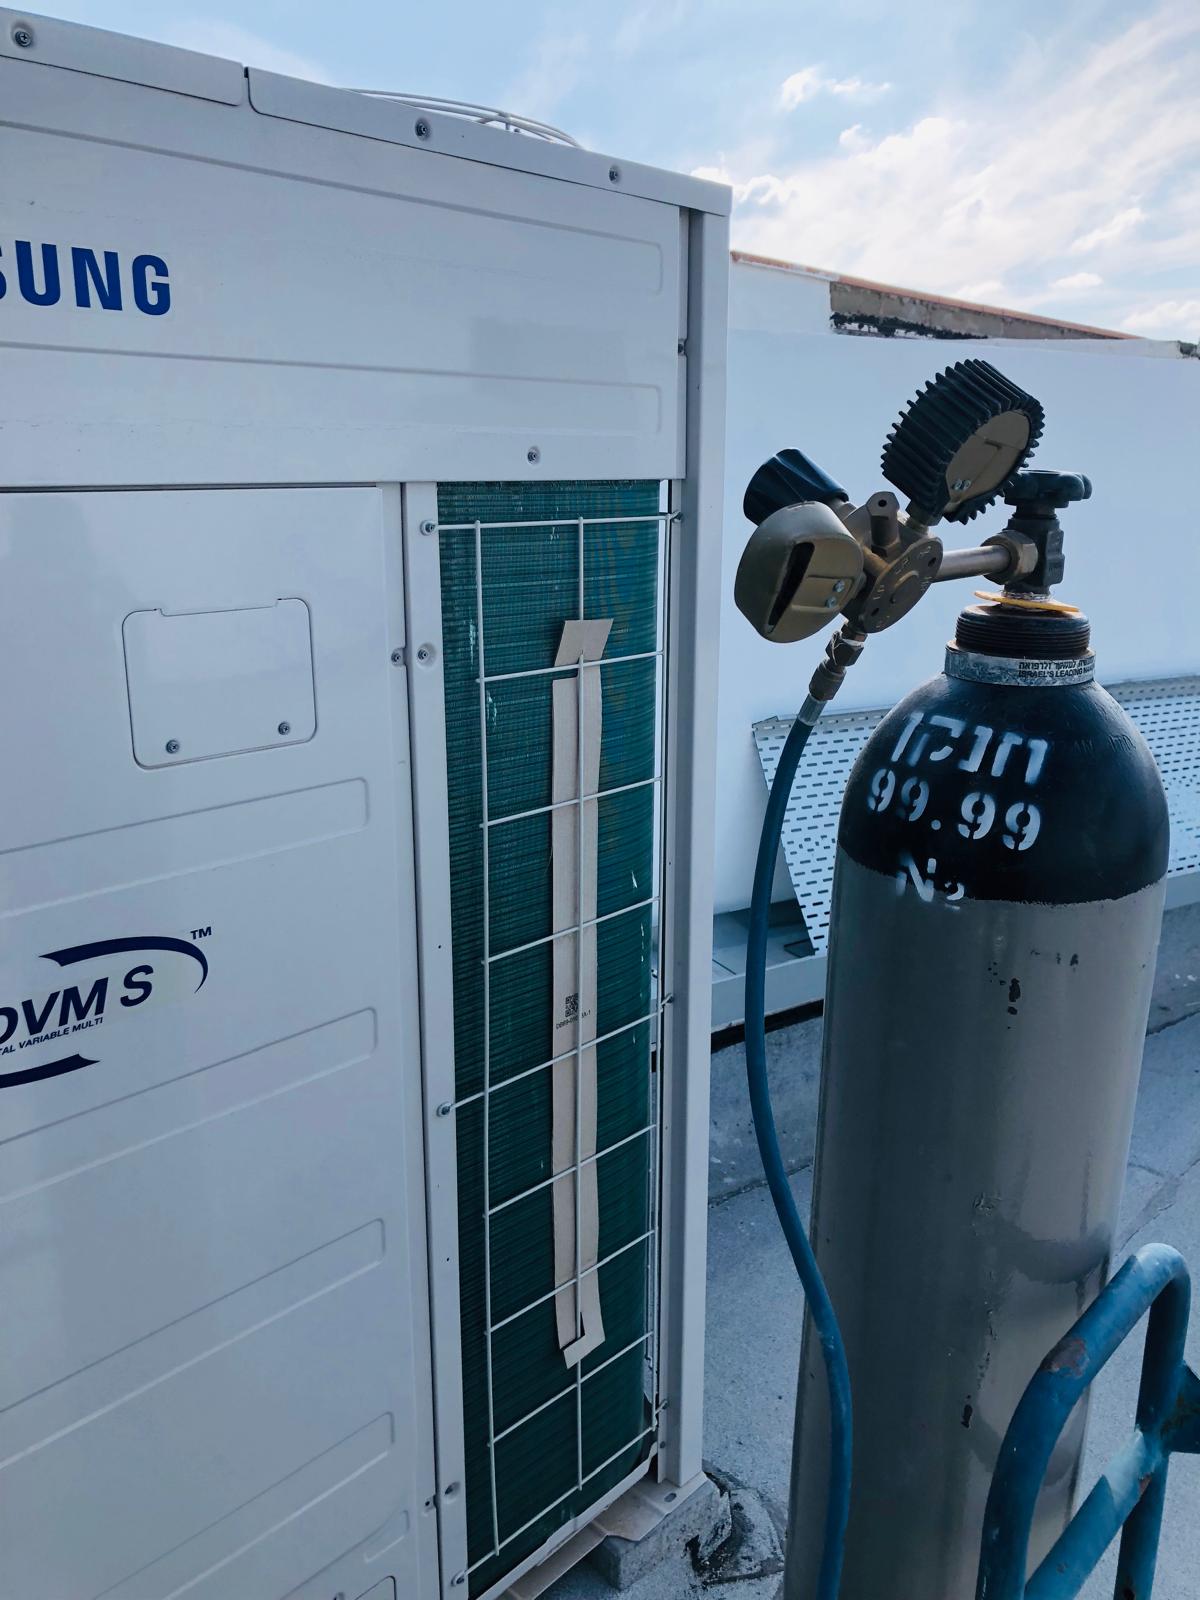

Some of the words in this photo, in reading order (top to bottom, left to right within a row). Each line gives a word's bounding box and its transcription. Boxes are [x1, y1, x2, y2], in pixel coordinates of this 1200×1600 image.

[0, 240, 170, 315] UNG
[1018, 669, 1054, 678] ISRAEL'S
[1055, 667, 1083, 677] LEADING
[868, 768, 1041, 850] 99.99
[190, 926, 212, 940] TM
[120, 964, 154, 1007] S
[0, 1045, 16, 1056] AL
[19, 1027, 70, 1049] VARIABLE
[72, 1017, 104, 1032] MULTI
